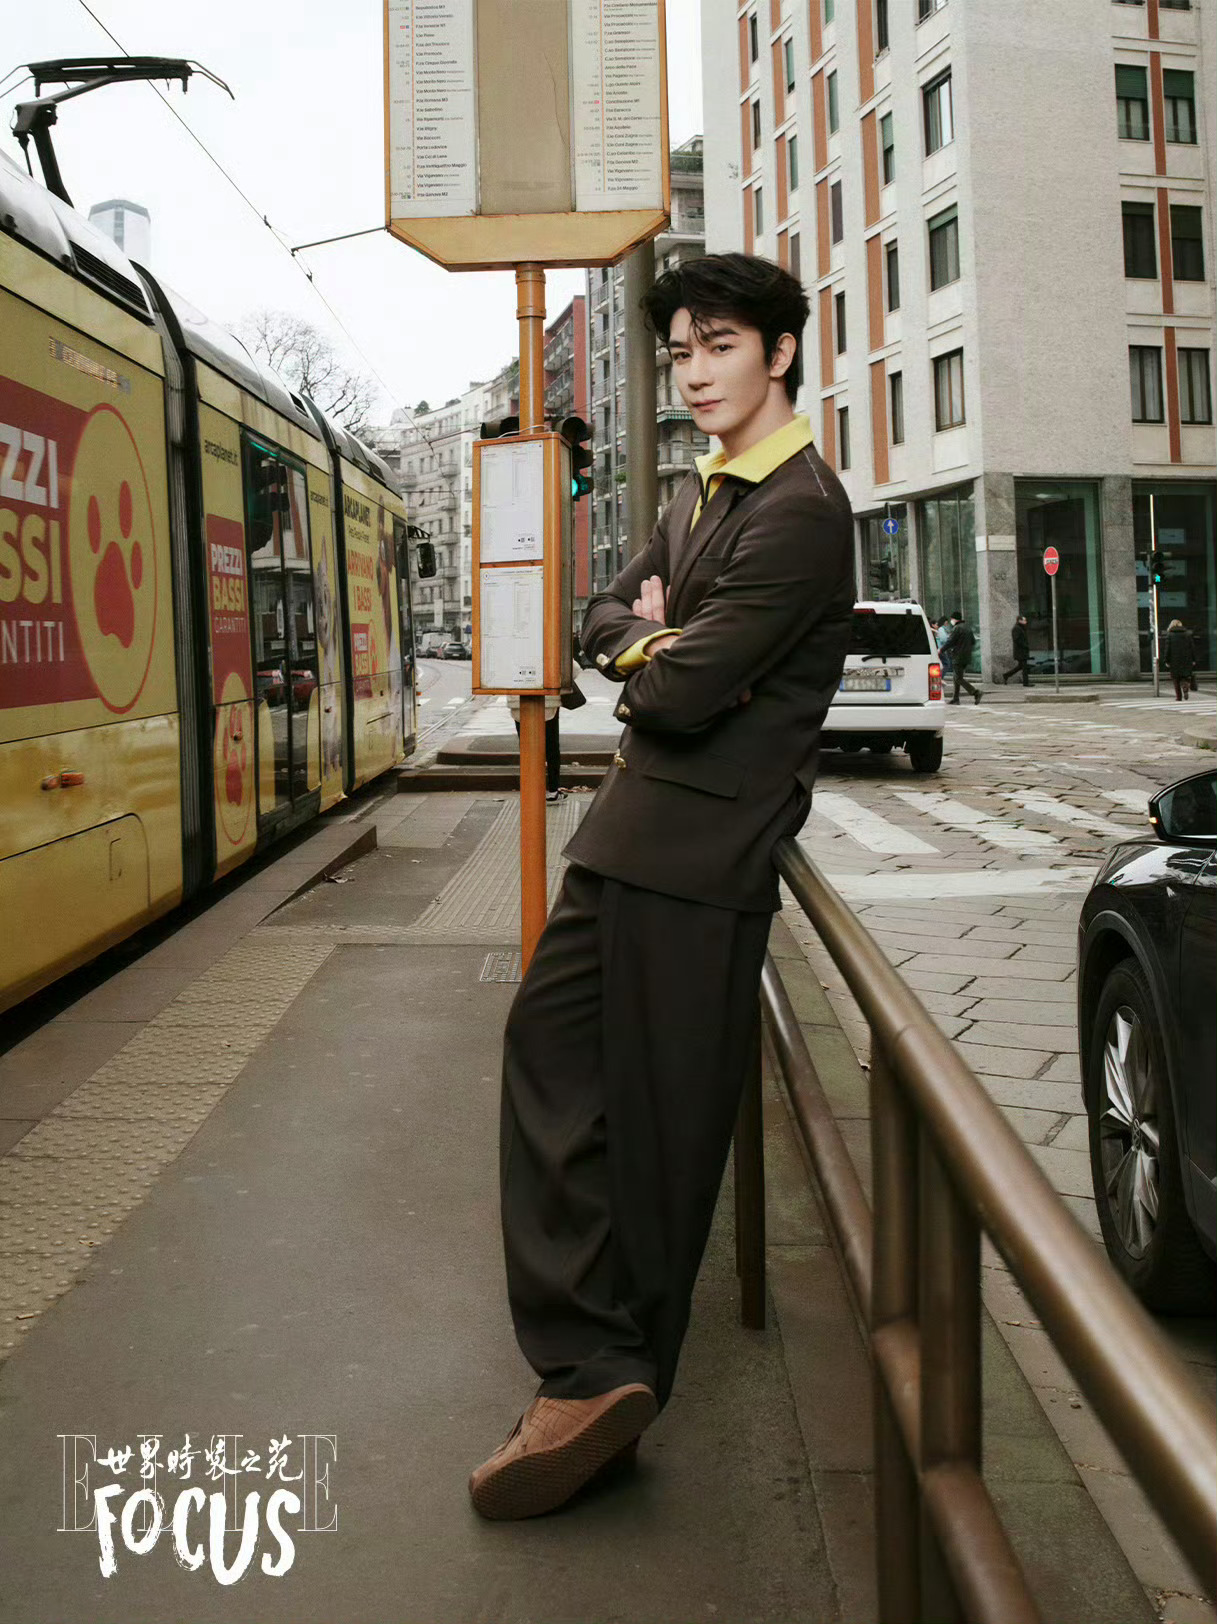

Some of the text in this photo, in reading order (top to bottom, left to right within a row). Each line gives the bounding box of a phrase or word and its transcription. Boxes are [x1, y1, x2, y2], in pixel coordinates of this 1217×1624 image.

[204, 439, 239, 466] arcaplanet.it
[210, 542, 243, 577] PREZZI
[213, 575, 245, 612] BASSI
